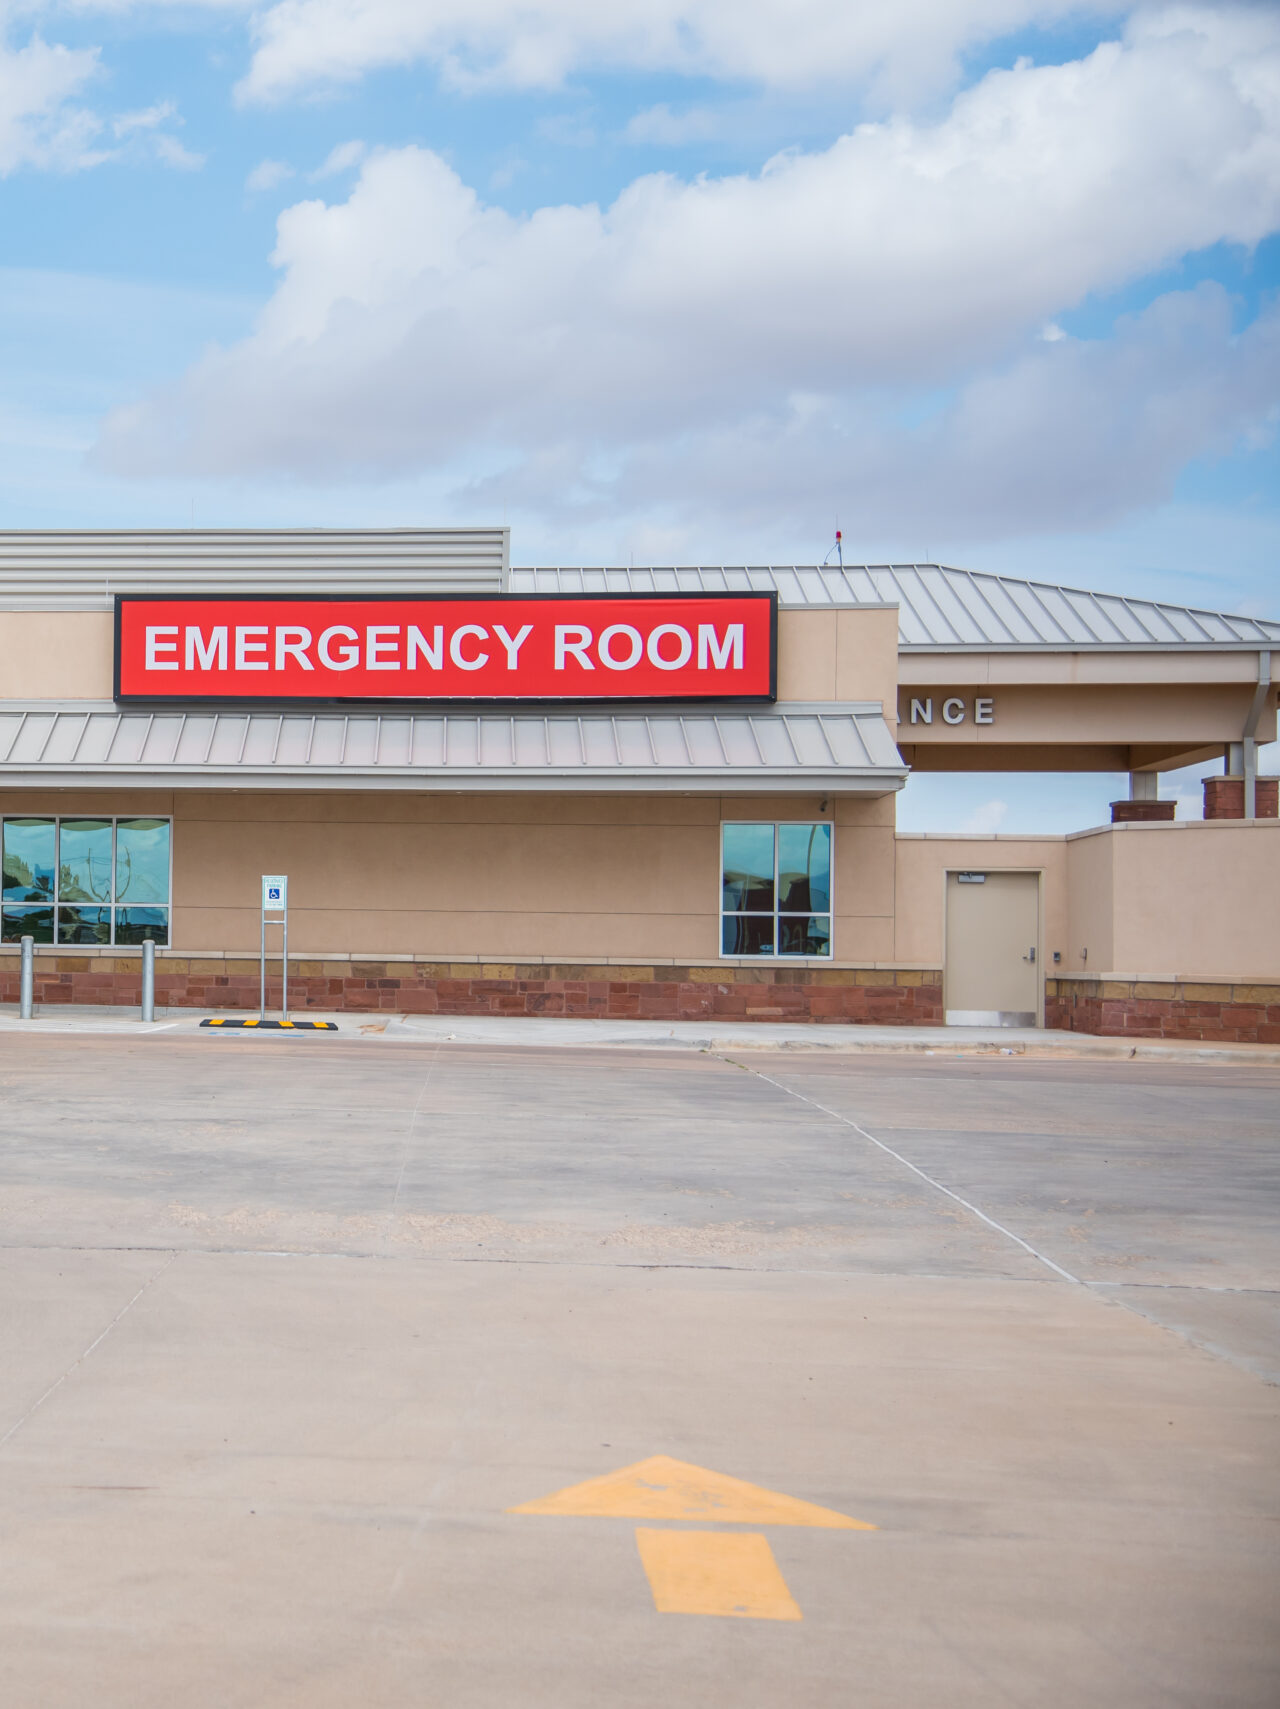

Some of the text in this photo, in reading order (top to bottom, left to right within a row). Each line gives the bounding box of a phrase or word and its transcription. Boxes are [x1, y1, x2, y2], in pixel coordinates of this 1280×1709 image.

[145, 623, 744, 671] EMERGENCY ROOM
[897, 697, 994, 725] NCE
